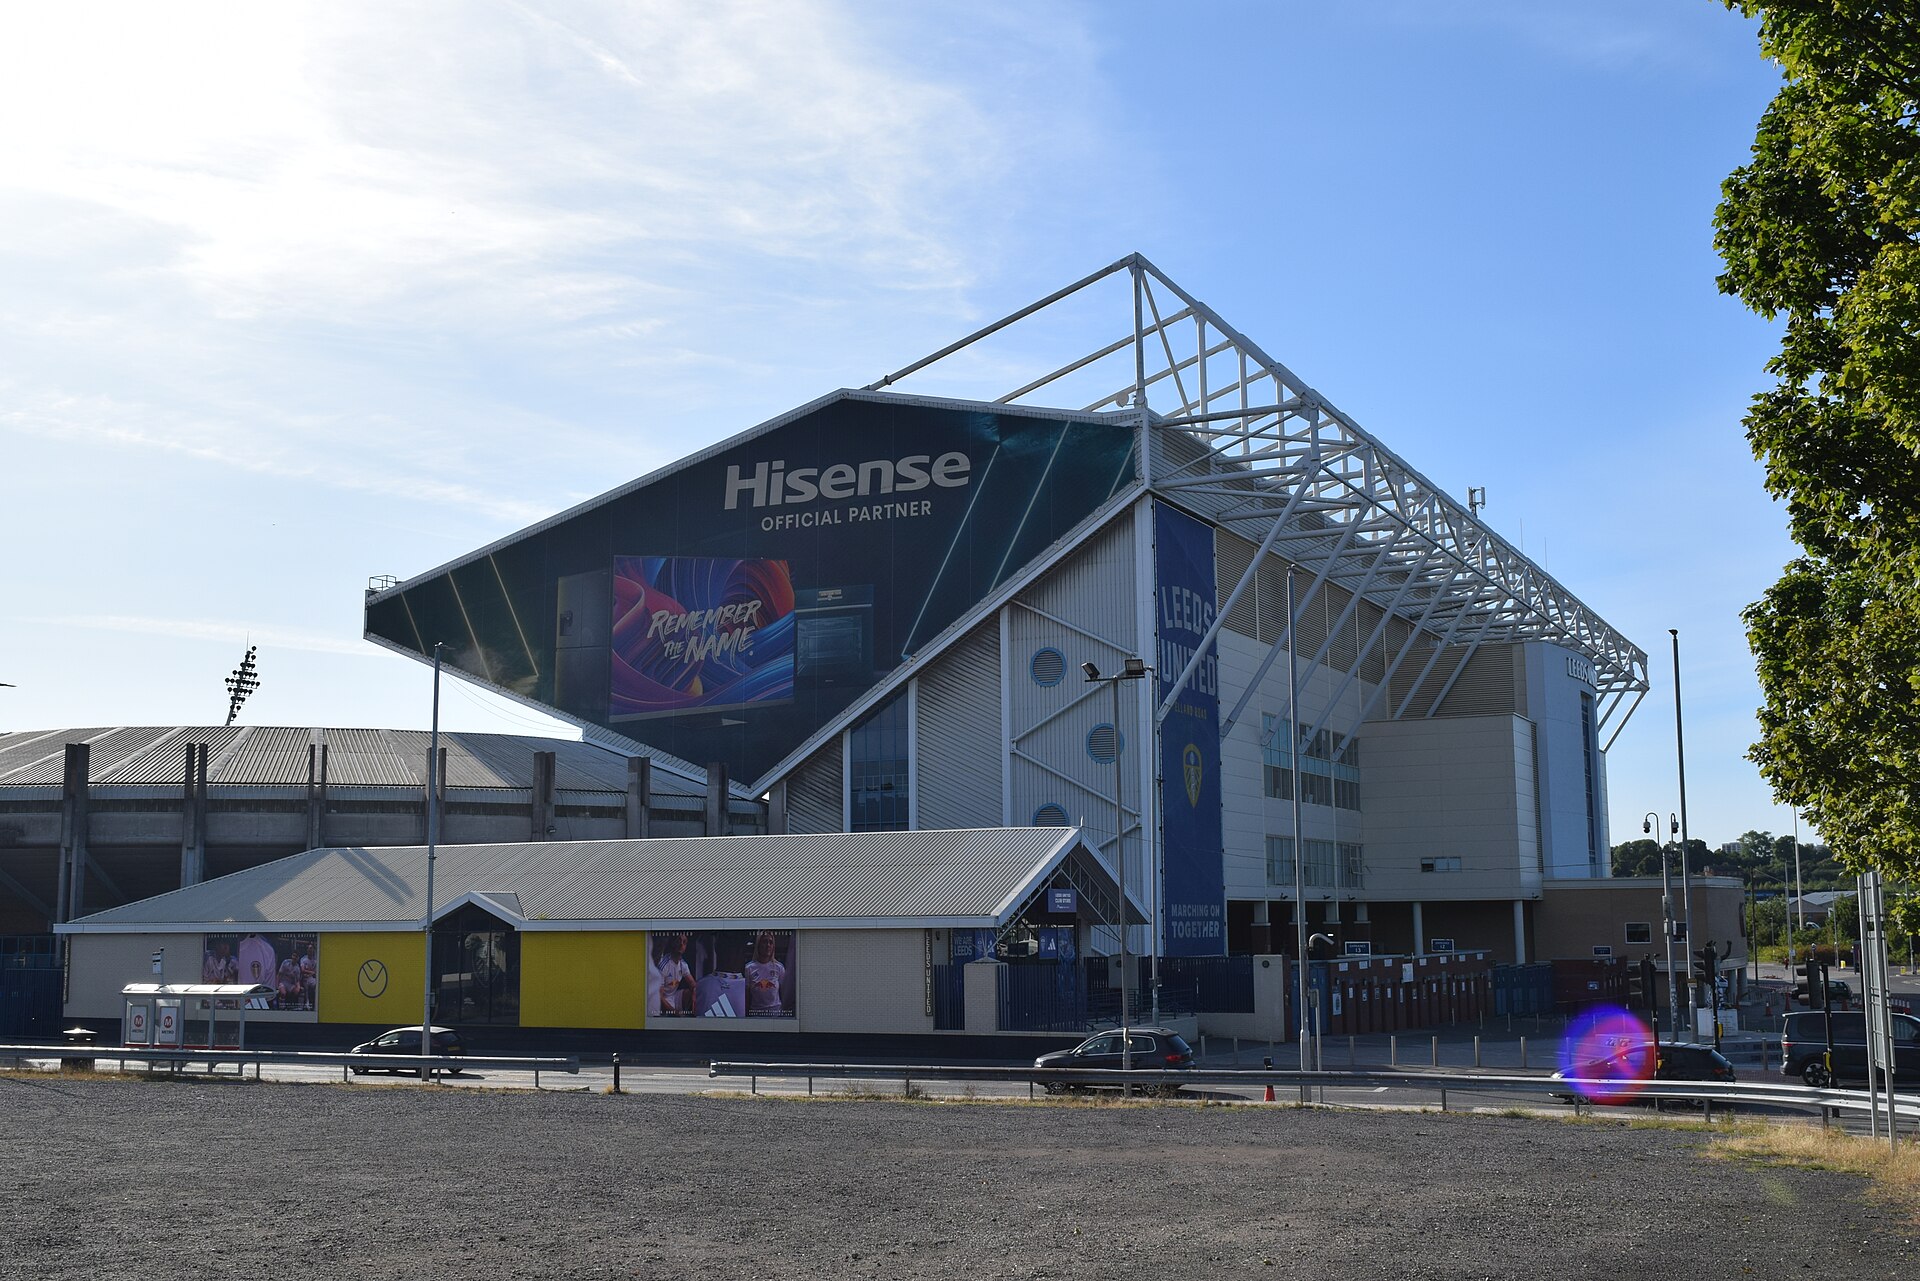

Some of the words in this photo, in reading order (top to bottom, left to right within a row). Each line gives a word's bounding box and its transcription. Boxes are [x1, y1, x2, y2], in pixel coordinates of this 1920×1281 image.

[724, 451, 970, 510] Hisense
[760, 508, 842, 532] OFFICIAL
[848, 500, 932, 523] PARTNER
[646, 599, 762, 640] REMEMBER
[1161, 585, 1213, 637] LEEDS
[663, 638, 685, 660] THE
[1171, 904, 1208, 917] MARCHING
[1210, 904, 1220, 916] ON
[1171, 920, 1220, 939] TOGETHER
[954, 945, 973, 956] LEEDS
